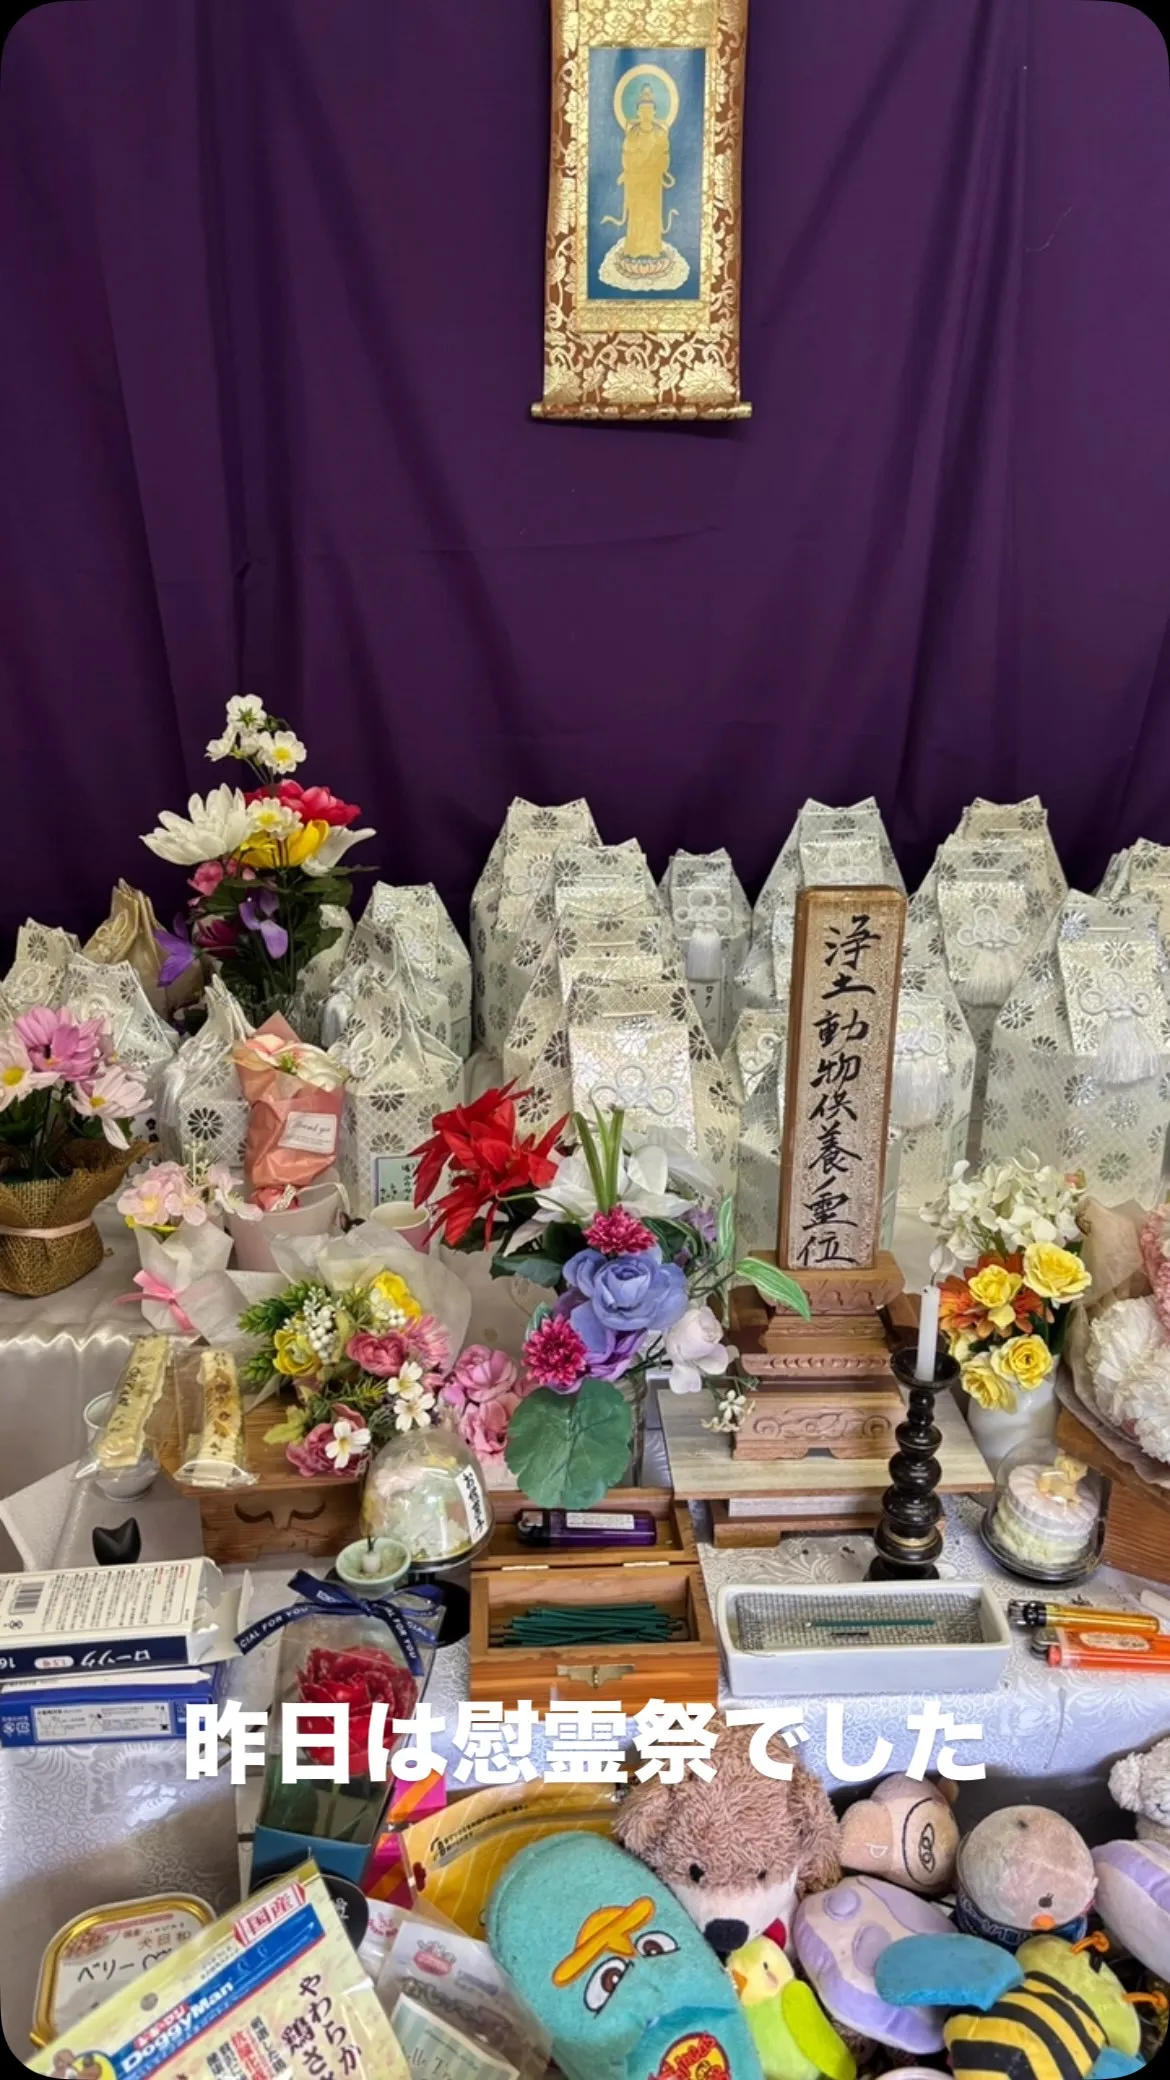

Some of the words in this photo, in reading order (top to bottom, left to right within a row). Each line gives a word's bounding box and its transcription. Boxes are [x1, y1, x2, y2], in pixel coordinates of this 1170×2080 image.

[262, 1616, 283, 1632] FOR
[80, 1649, 151, 1668] ローソク
[246, 1893, 295, 1936] 国産
[120, 1979, 236, 2073] DoggyMan
[298, 1973, 362, 2076] やわらか
